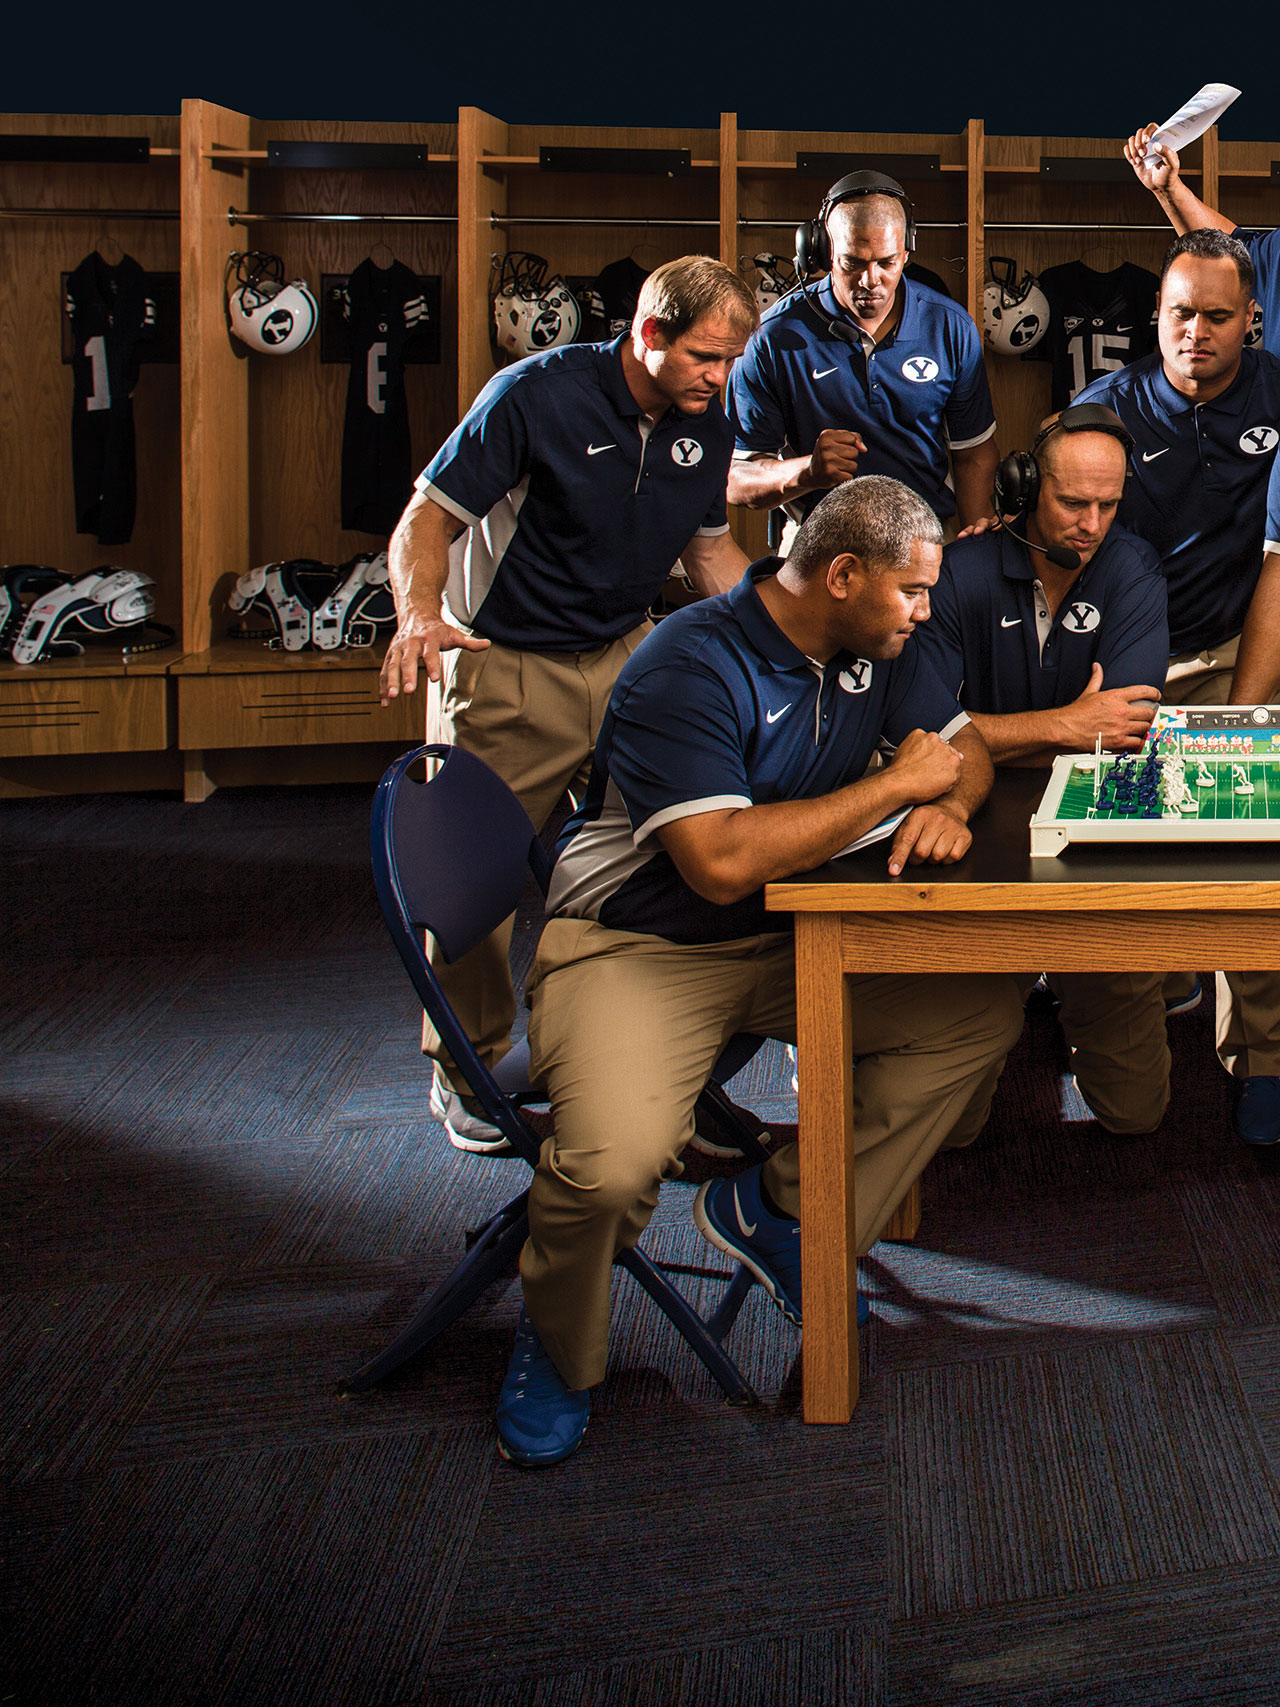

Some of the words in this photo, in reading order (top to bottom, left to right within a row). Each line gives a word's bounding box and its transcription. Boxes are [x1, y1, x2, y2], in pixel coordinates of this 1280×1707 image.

[264, 316, 292, 343] Y
[534, 317, 560, 343] Y
[1014, 320, 1038, 345] Y
[85, 335, 112, 412] 1
[906, 358, 933, 380] Y
[675, 439, 699, 464] Y
[1242, 428, 1272, 453] Y
[1066, 602, 1095, 631] Y
[846, 660, 870, 690] Y
